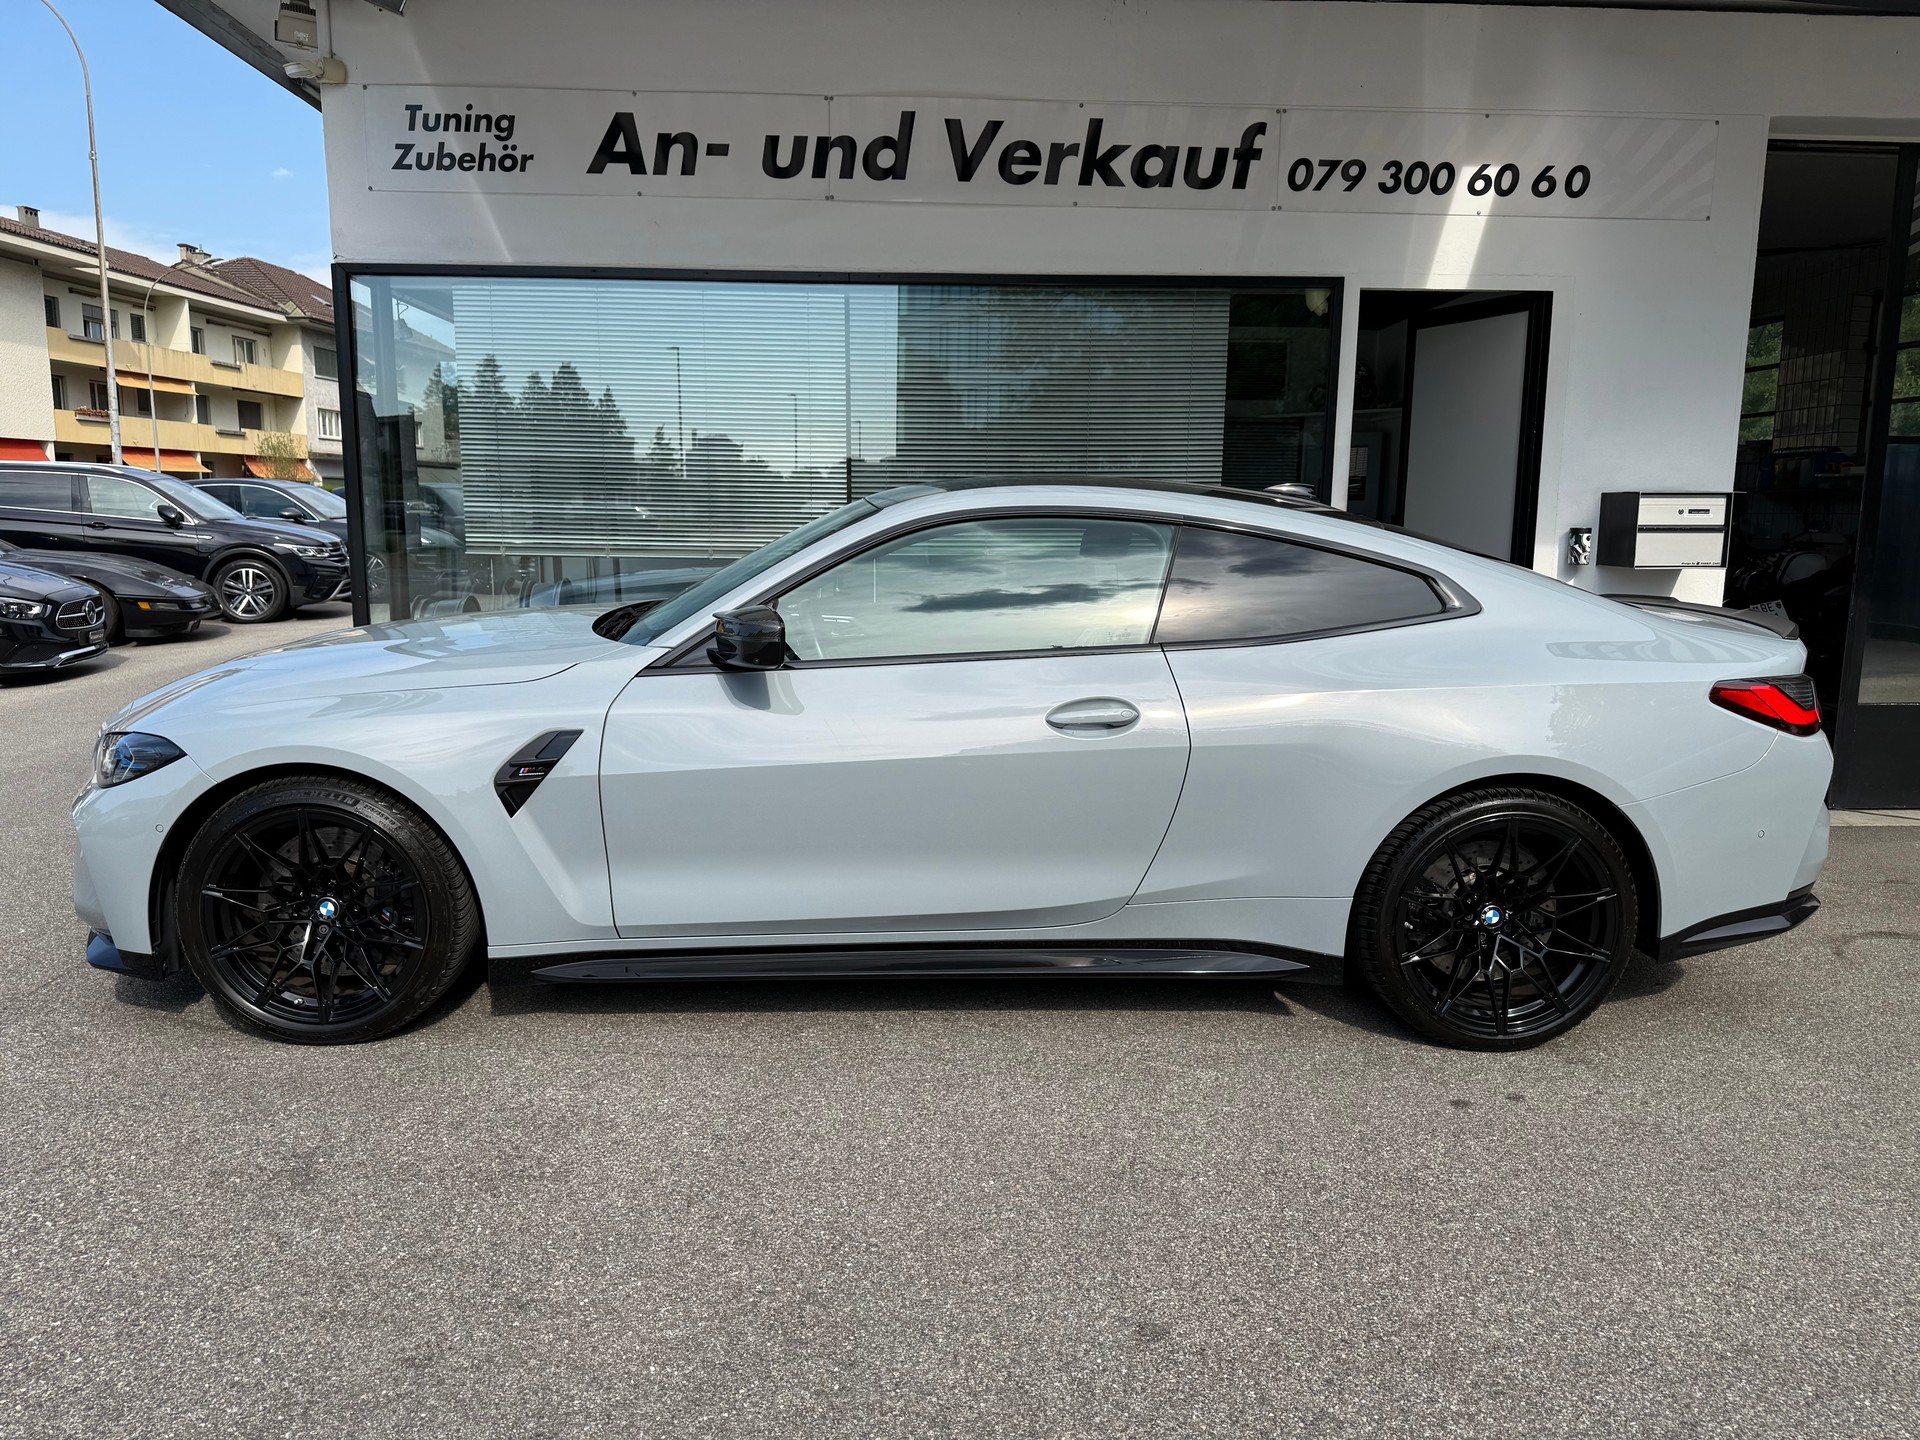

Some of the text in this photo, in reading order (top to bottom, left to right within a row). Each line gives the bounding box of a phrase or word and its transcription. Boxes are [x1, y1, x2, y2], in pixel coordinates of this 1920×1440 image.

[404, 104, 516, 143] Tuning
[391, 142, 535, 173] Zubehör
[586, 110, 1268, 191] An- und Verkauf
[1287, 157, 1367, 193] 079
[1377, 159, 1456, 196] 300
[1467, 163, 1520, 198] 60
[1760, 602, 1775, 613] BE
